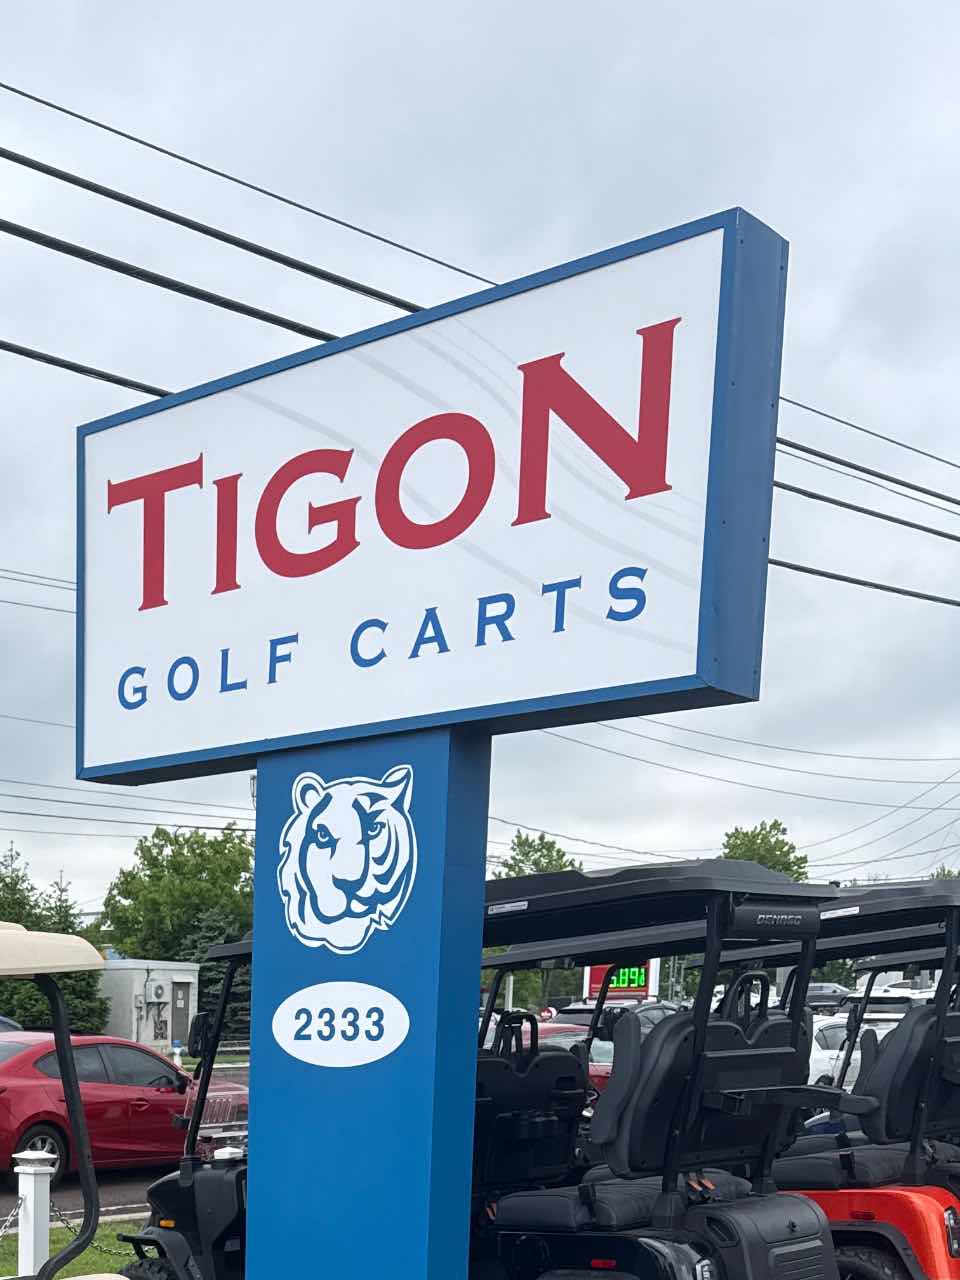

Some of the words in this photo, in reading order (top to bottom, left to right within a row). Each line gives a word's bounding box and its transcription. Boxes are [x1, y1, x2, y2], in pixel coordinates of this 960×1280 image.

[107, 317, 682, 611] TIGON
[117, 633, 299, 711] GOLF
[350, 566, 648, 668] CARTS
[293, 1006, 385, 1042] 2333
